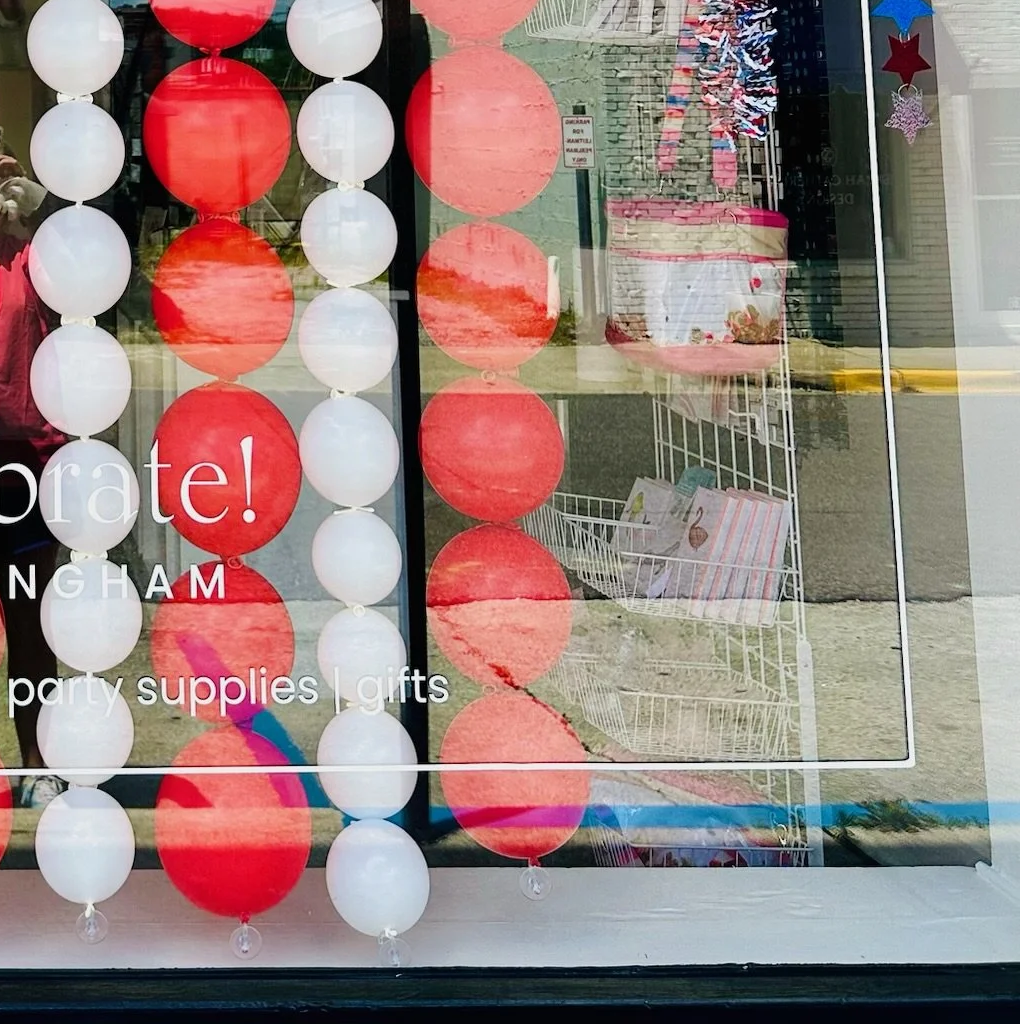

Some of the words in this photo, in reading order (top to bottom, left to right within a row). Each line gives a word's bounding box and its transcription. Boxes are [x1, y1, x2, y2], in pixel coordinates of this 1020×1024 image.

[7, 671, 125, 719] party
[136, 666, 319, 718] supplies
[355, 665, 450, 716] gifts
